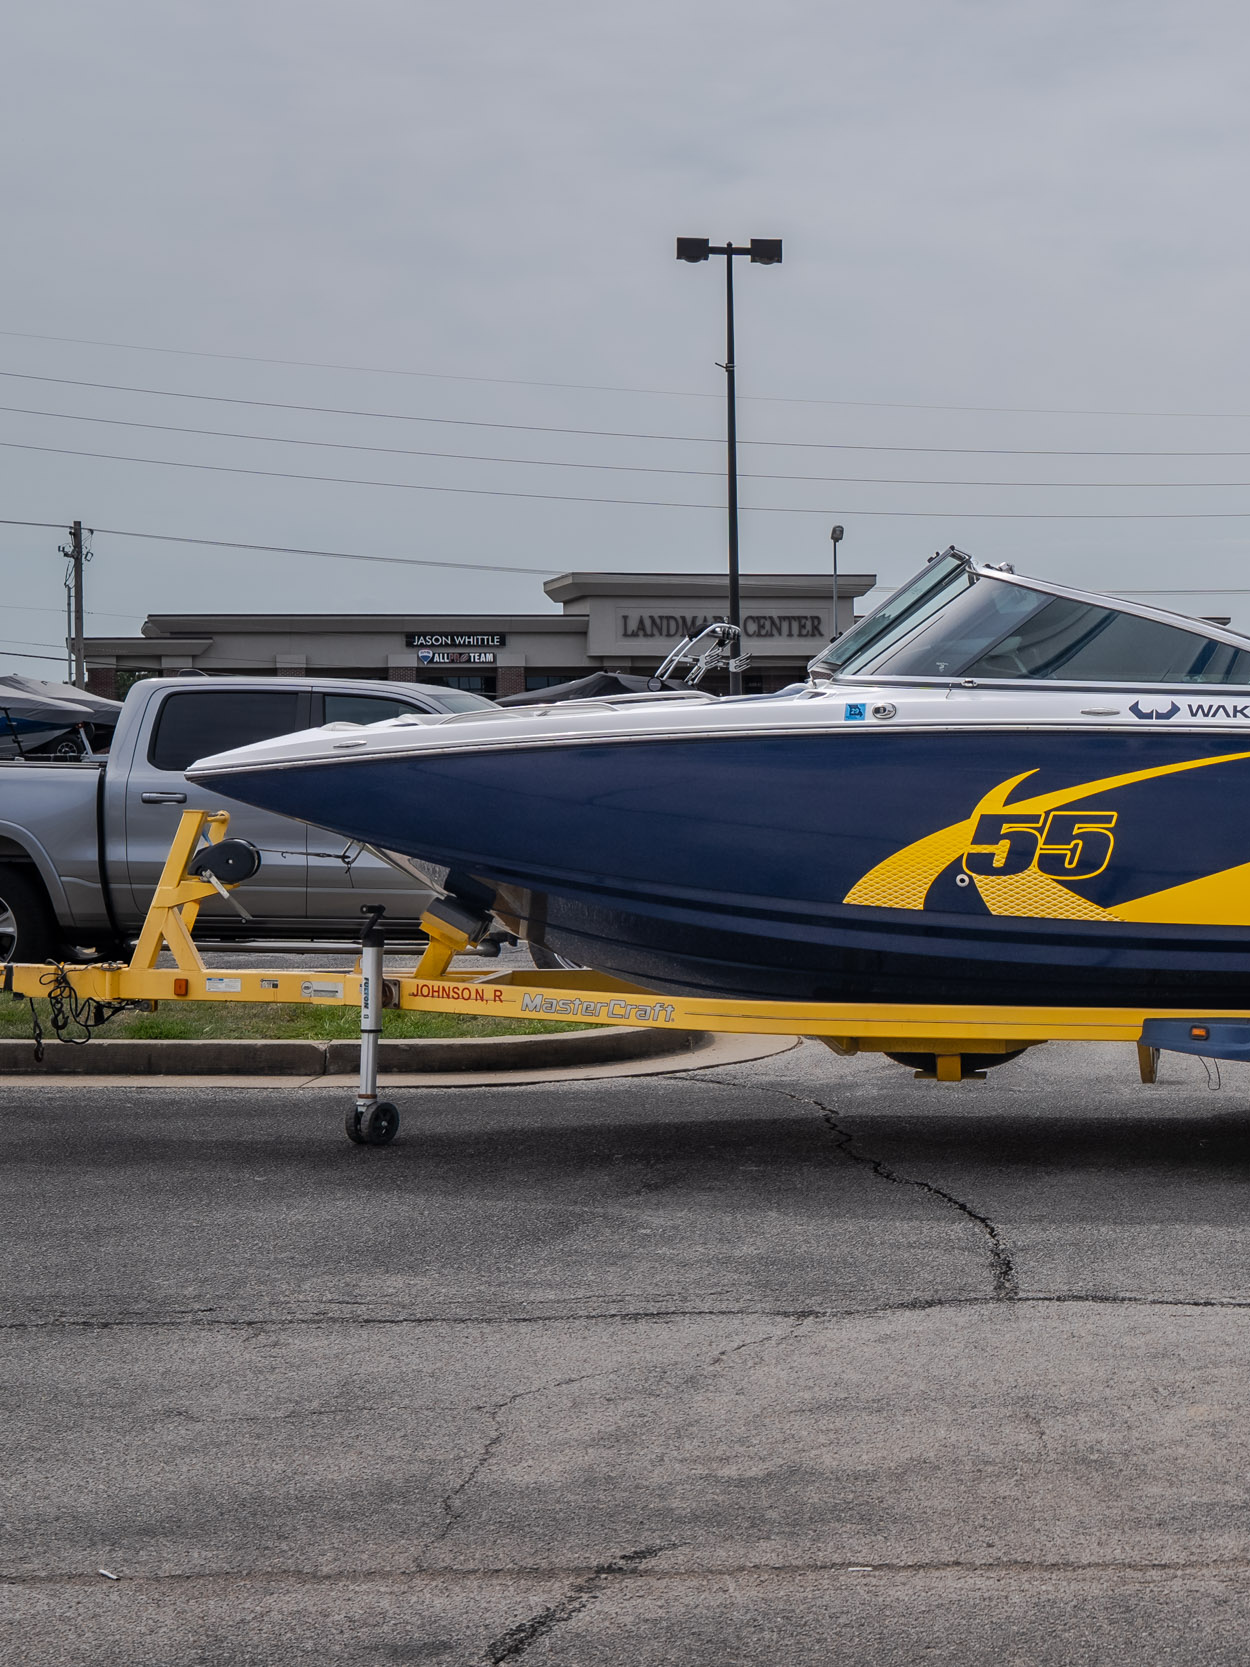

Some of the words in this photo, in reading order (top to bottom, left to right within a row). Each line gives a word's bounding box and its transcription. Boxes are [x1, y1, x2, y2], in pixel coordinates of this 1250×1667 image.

[621, 614, 731, 638] LANDM
[743, 614, 825, 639] CENTER
[413, 635, 451, 646] JASON
[454, 635, 500, 645] WHITTLE
[469, 652, 494, 663] TEAM
[962, 811, 1118, 880] 55
[493, 989, 503, 1003] R
[521, 992, 676, 1023] MasterCraft
